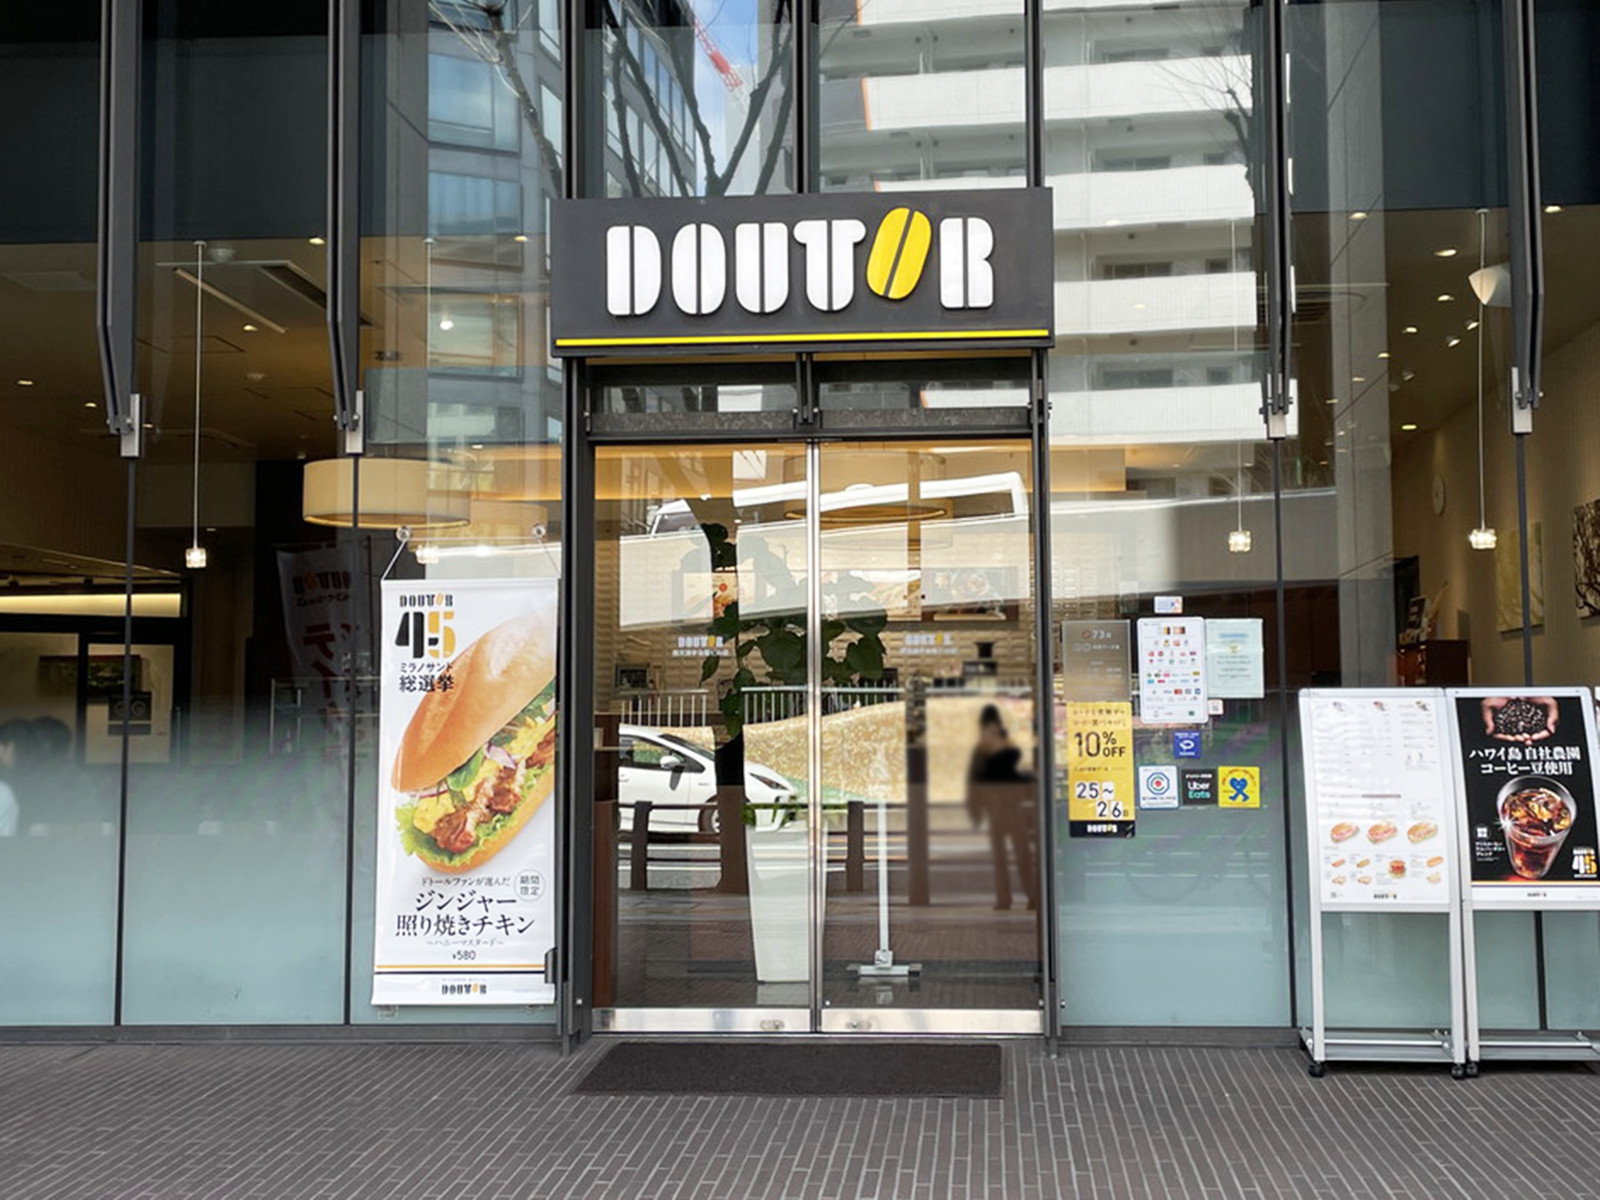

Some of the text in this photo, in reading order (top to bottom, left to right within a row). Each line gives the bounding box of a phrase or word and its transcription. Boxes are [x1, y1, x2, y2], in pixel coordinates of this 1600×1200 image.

[606, 207, 994, 316] DOUTOR
[399, 593, 454, 607] DOUTOR
[395, 611, 456, 659] 45
[399, 674, 454, 693] 総選挙
[1102, 746, 1126, 758] OFF
[1469, 746, 1522, 760] ハワイ島
[1481, 761, 1573, 775] コーヒー豆使用
[1187, 781, 1211, 791] Uber
[1188, 790, 1211, 799] Eats
[1571, 854, 1598, 874] 45
[415, 890, 517, 913] ジンジャー
[395, 914, 536, 937] 照り焼きチキン
[441, 983, 488, 995] DOUTOR
